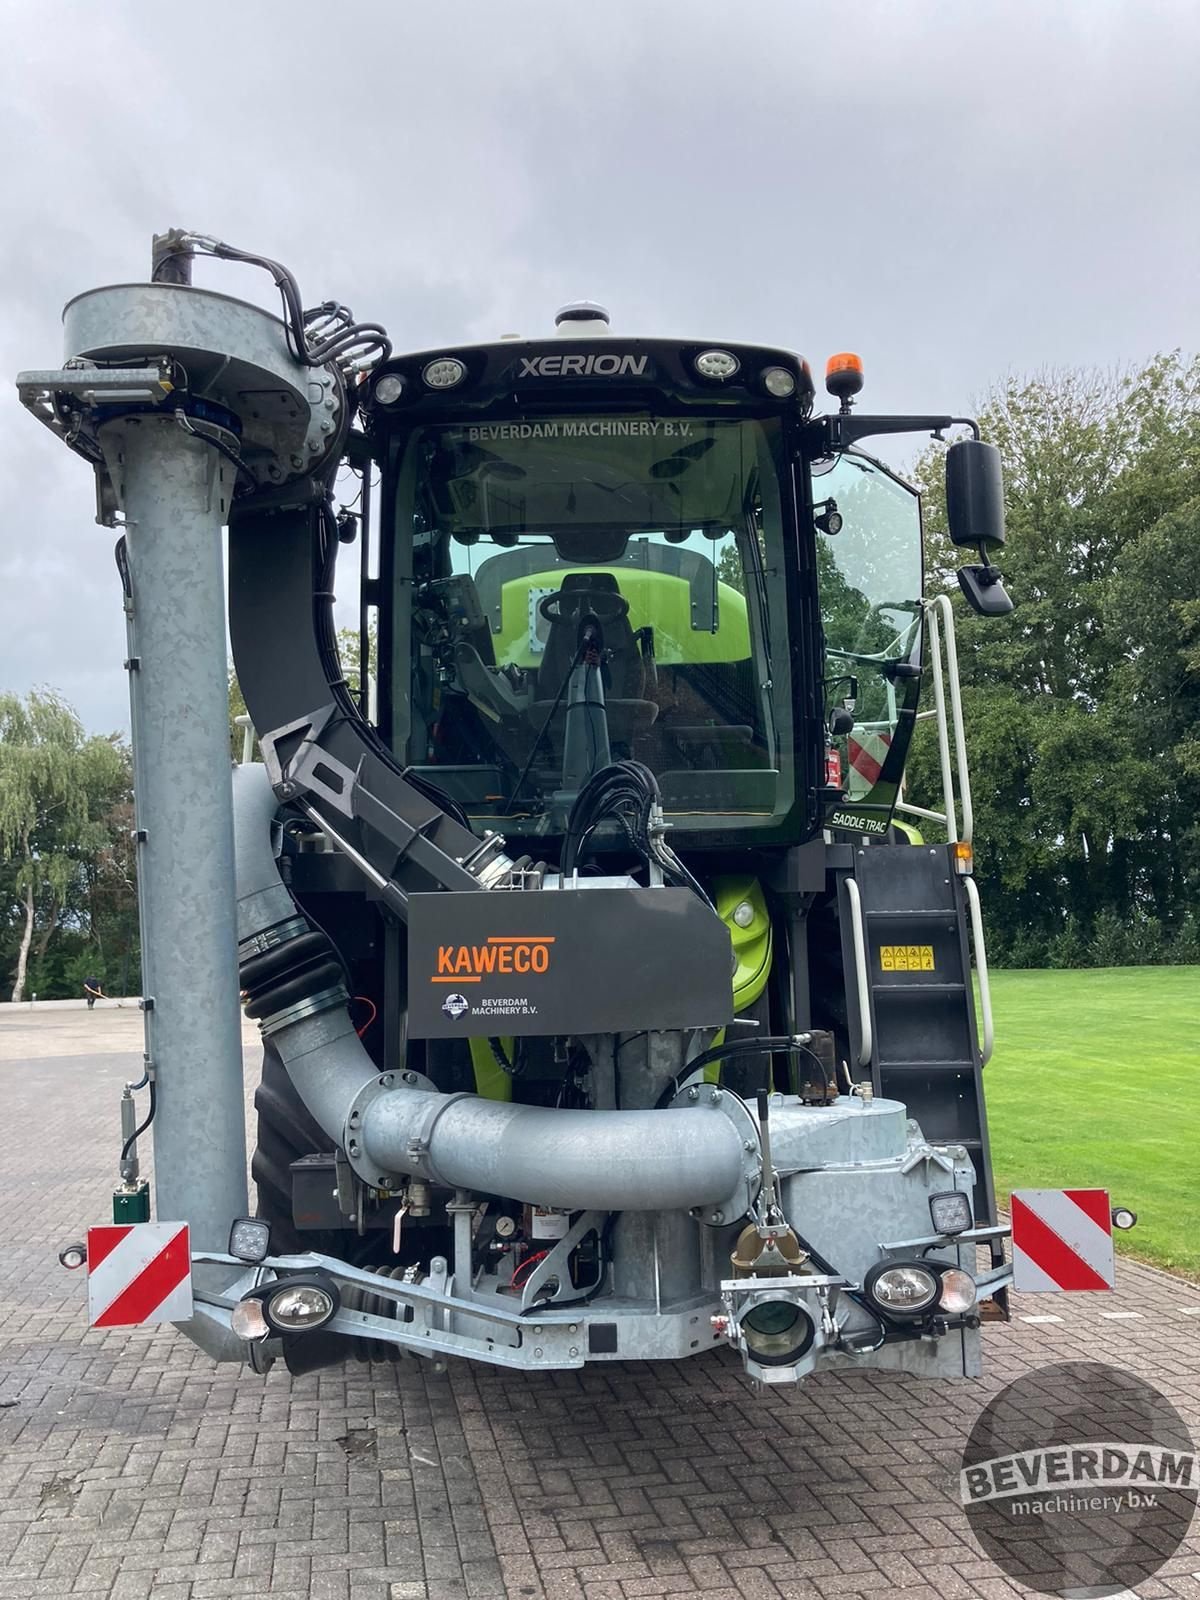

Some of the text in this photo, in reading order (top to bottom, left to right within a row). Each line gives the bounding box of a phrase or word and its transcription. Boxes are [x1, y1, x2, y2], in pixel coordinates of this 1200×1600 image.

[518, 354, 648, 378] XERION
[469, 422, 694, 441] BEVERDAM MACHINERY B.V.
[832, 812, 887, 833] SADDLE TRAC
[437, 945, 549, 974] KAWECO
[471, 1006, 521, 1015] MACHINERY
[522, 1006, 538, 1014] B.V.
[481, 998, 528, 1007] BEVERDAM
